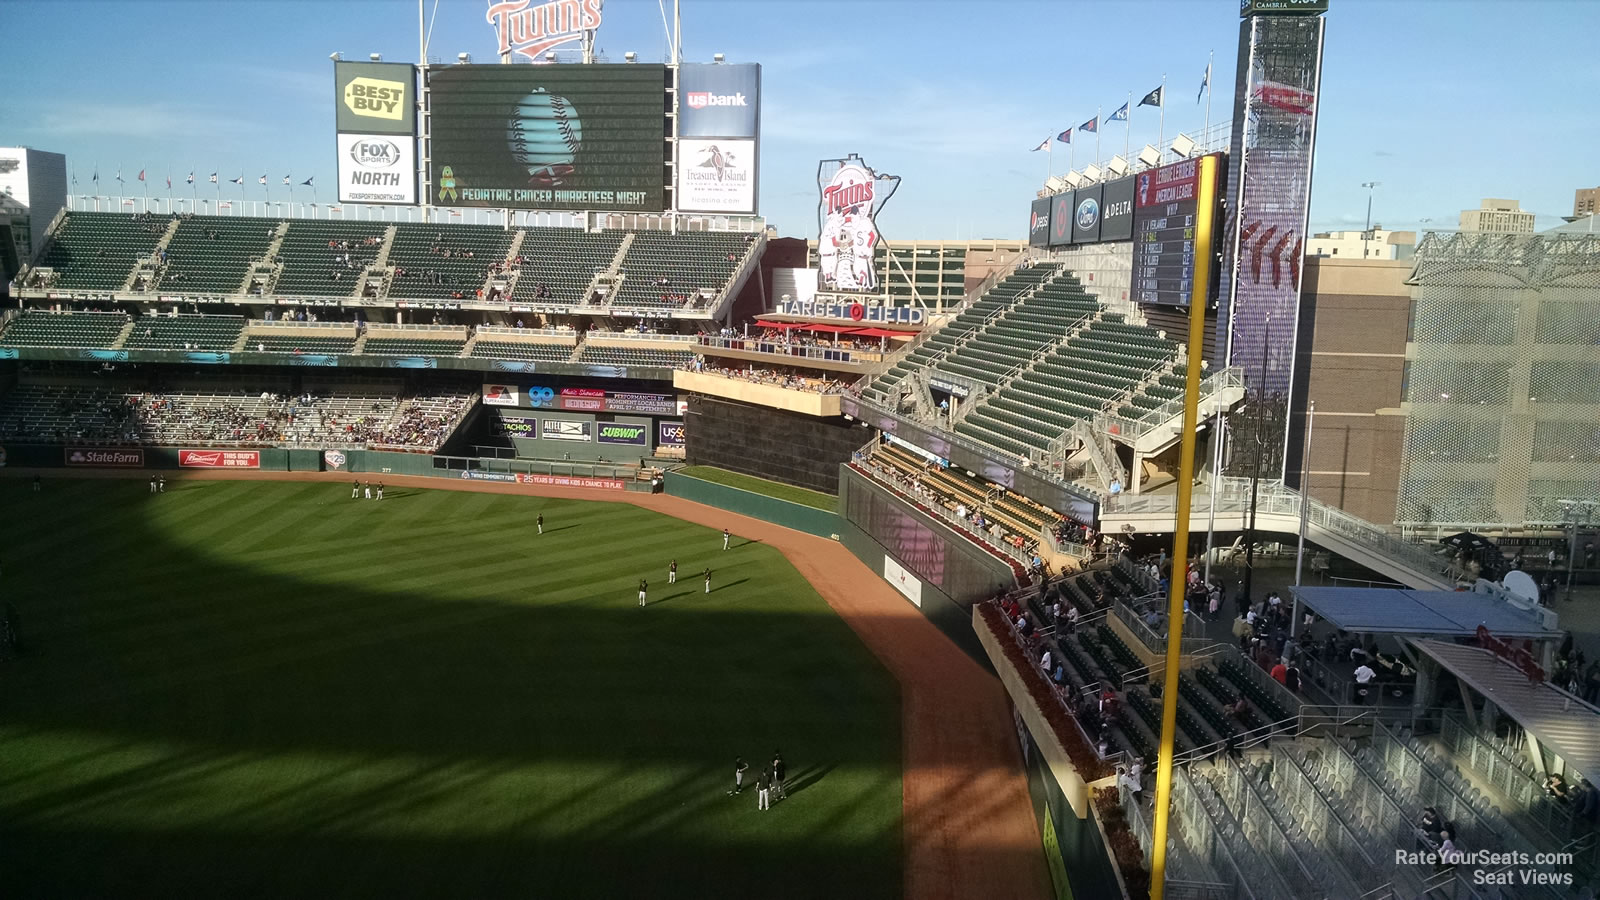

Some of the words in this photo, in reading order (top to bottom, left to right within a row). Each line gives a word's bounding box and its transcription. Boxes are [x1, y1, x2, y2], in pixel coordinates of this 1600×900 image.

[486, 0, 602, 55] Twins
[352, 84, 402, 101] BEST
[354, 97, 398, 113] BUY
[360, 144, 390, 158] FOX
[352, 170, 400, 186] NORTH
[686, 168, 717, 181] Treasure
[724, 168, 746, 182] Island
[349, 192, 405, 200] FOXSPORTSNORTH.COM
[462, 188, 512, 201] PEDIATRIC
[514, 189, 552, 202] CANCER
[554, 190, 614, 204] AWARENESS
[616, 192, 647, 204] NIGHT
[824, 179, 874, 216] Twins
[1080, 206, 1095, 224] Ford
[1110, 200, 1132, 216] DELTA
[1037, 213, 1048, 231] pepsi
[782, 300, 846, 318] TARGET
[866, 305, 924, 324] FIELD
[600, 427, 644, 439] SUBWAY
